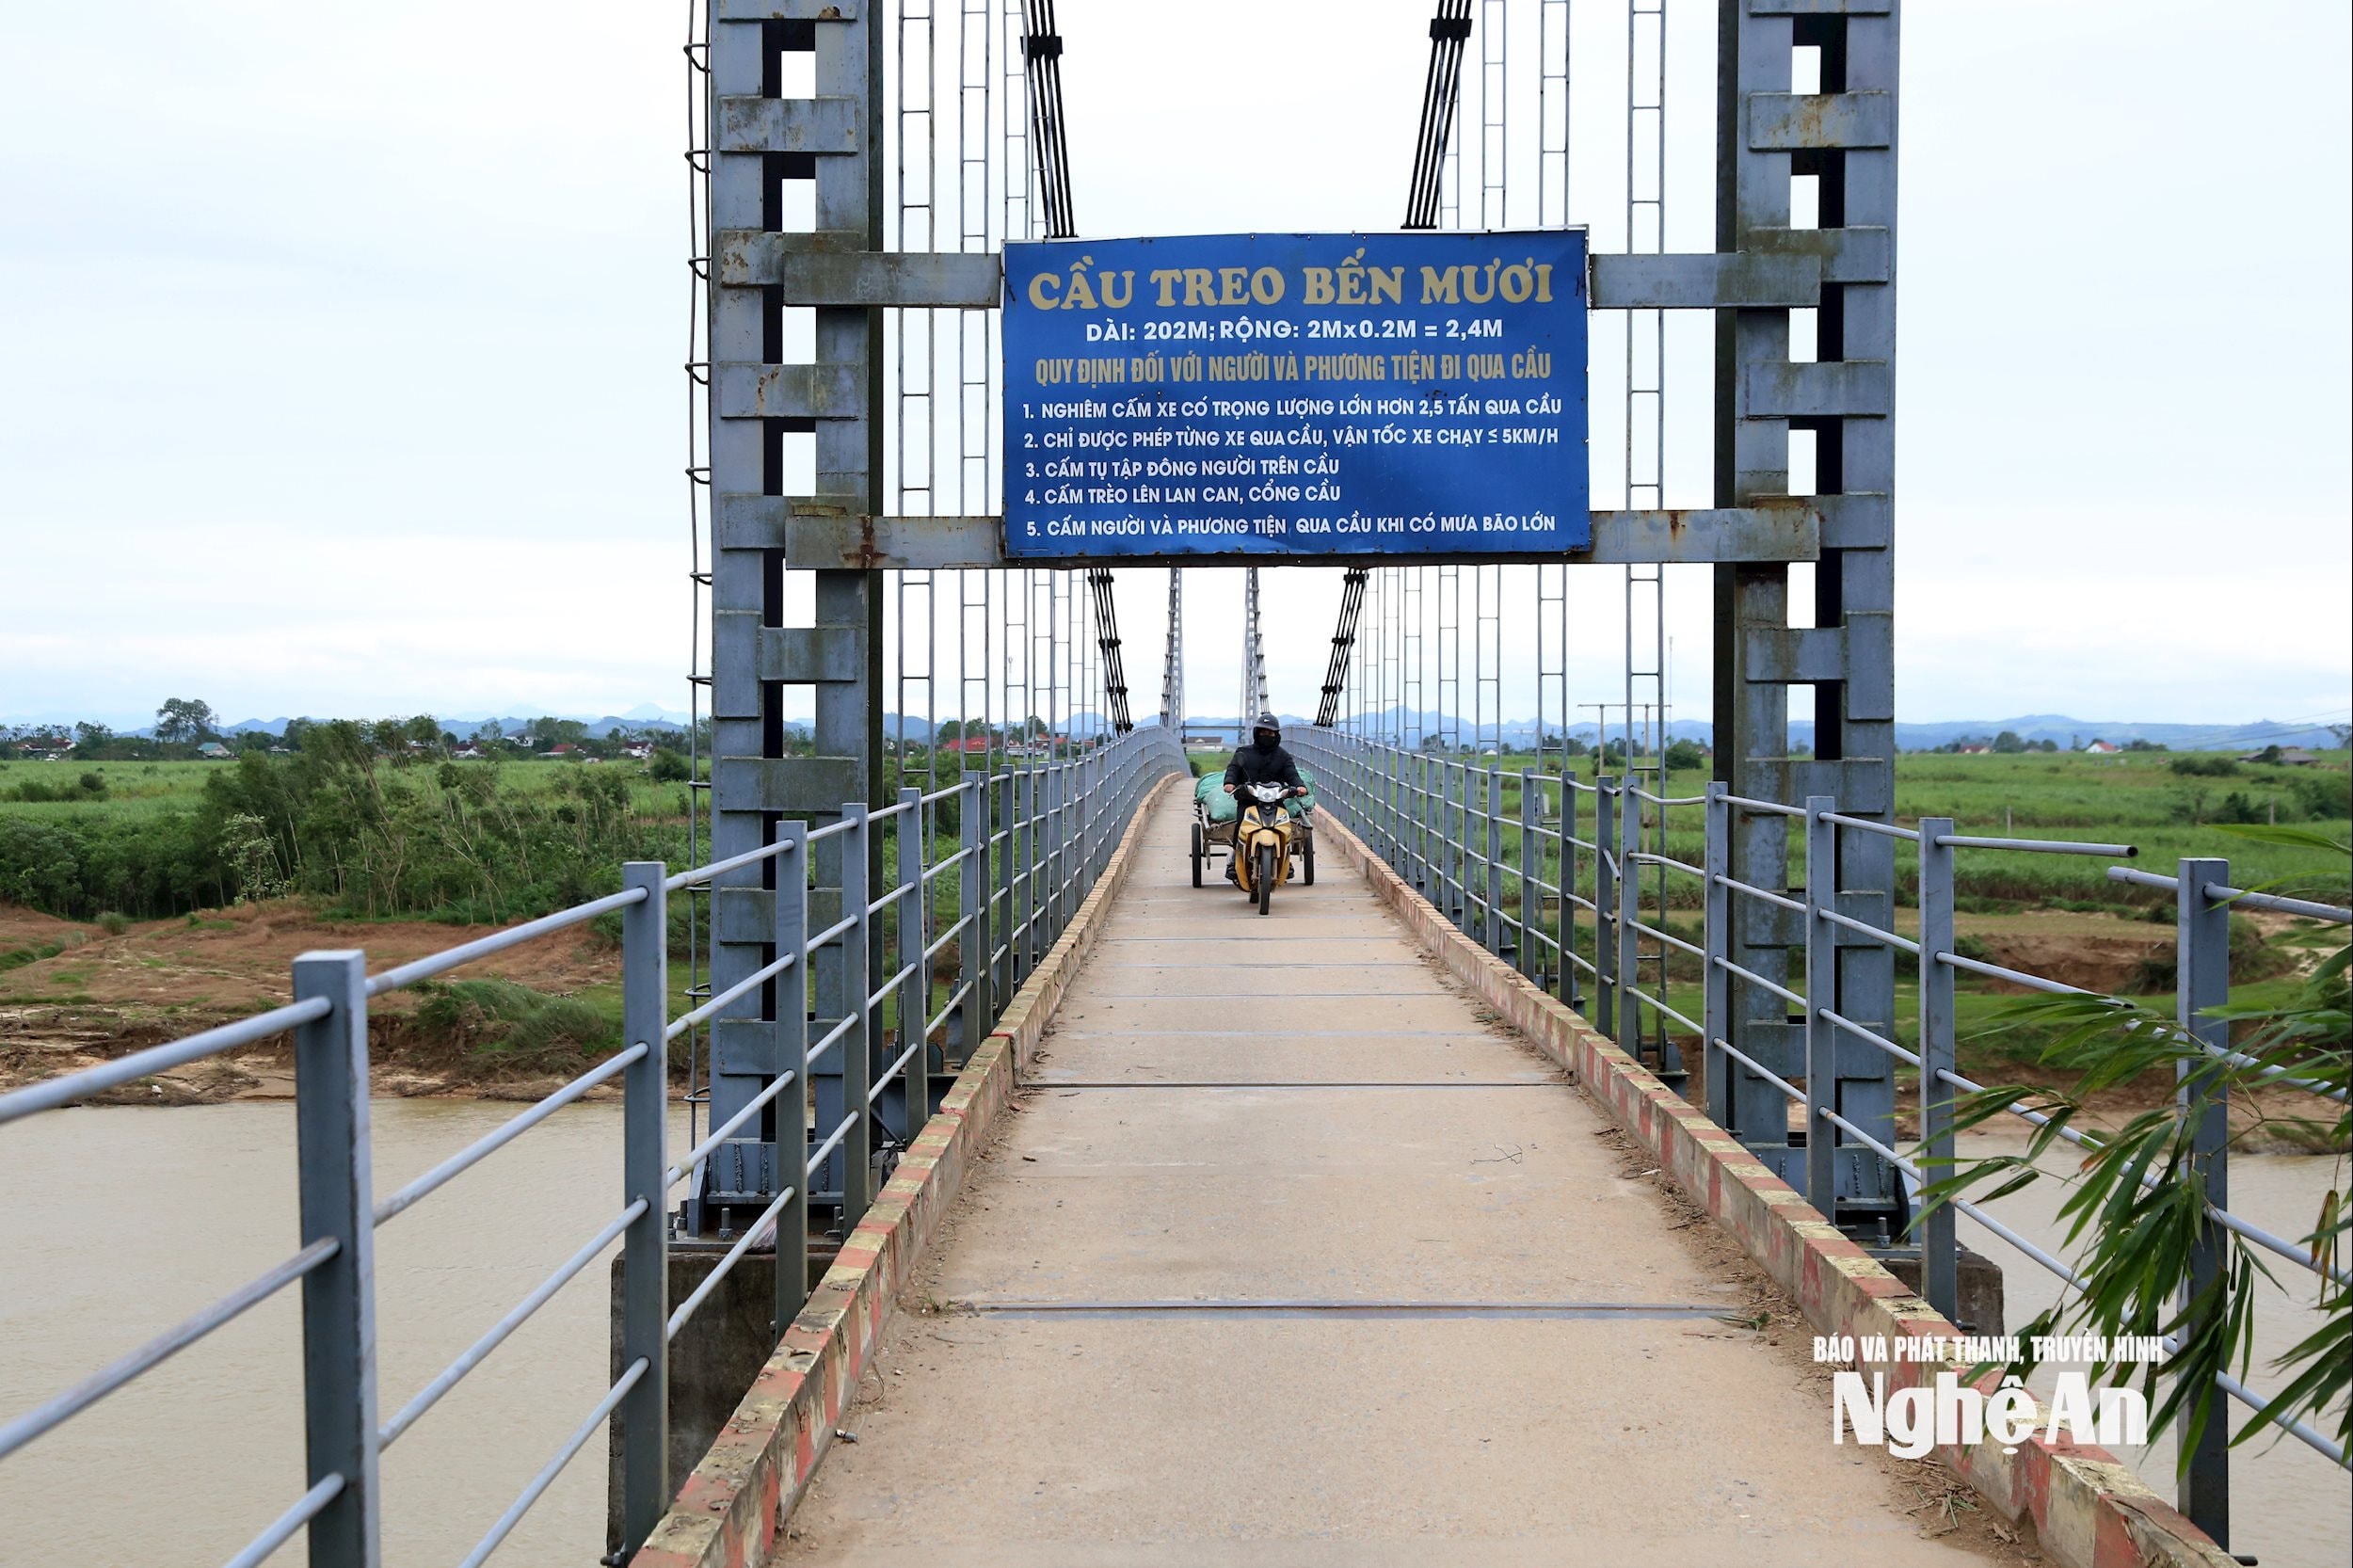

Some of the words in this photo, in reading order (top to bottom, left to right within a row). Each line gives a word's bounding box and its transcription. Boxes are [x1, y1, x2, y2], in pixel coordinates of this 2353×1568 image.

[1028, 255, 1135, 311] CẦU
[1150, 266, 1285, 308] TREO
[1303, 248, 1404, 305] BẾN
[1420, 257, 1553, 304] MƯƠI
[1087, 318, 1135, 342] DÀI:
[1425, 325, 1437, 337] =
[1446, 319, 1502, 341] 2,4M
[1035, 359, 1073, 386] QUY
[1078, 359, 1125, 388] ĐỊNH
[1131, 349, 1163, 383] ĐỐI
[1171, 349, 1202, 382] VỚI
[1209, 352, 1269, 382] NGƯỜI
[1273, 351, 1299, 380] VÀ
[1305, 353, 1385, 381] PHƯƠNG
[1392, 349, 1434, 385] TIỆN
[1441, 353, 1460, 379] ĐI
[1467, 353, 1505, 382] QUA
[1512, 345, 1550, 378] CẦU
[1023, 404, 1033, 419] 1.
[1042, 400, 1107, 419] NGHIÊM
[1112, 396, 1151, 418] CẤM
[1157, 402, 1176, 418] XE
[1181, 396, 1208, 417] CÓ
[1212, 401, 1270, 420] TRỌNG
[1277, 396, 1335, 420] LƯỢNG
[1340, 395, 1372, 415] LỚN
[1378, 398, 1414, 415] HƠN
[1418, 400, 1443, 418] 2,5
[1449, 393, 1480, 414] TẤN
[1485, 399, 1520, 415] QUA
[1526, 392, 1561, 414] CẦU
[1024, 434, 1038, 449] 2.
[1043, 426, 1073, 448] CHỈ
[1079, 430, 1128, 452] ĐƯỢC
[1132, 427, 1172, 447] PHÉP
[1176, 425, 1220, 446] TỪNG
[1225, 430, 1245, 446] XE
[1250, 430, 1285, 447] QUA
[1288, 423, 1327, 447] CẦU,
[1333, 425, 1368, 447] VẬN
[1372, 423, 1406, 444] TỐC
[1413, 429, 1432, 444] XE
[1437, 428, 1483, 447] CHẠY
[1502, 427, 1559, 444] 5KM/H
[1025, 464, 1040, 478] 3.
[1045, 456, 1083, 477] CẤM
[1089, 462, 1107, 480] TỤ
[1112, 458, 1143, 480] TẬP
[1146, 457, 1197, 477] ĐÔNG
[1202, 454, 1256, 476] NGƯỜI
[1260, 456, 1299, 474] TRÊN
[1303, 452, 1339, 474] CẦU
[1025, 490, 1040, 504] 4.
[1044, 483, 1082, 504] CẤM
[1088, 484, 1128, 504] TRÈO
[1132, 484, 1160, 504] LÊN
[1165, 487, 1195, 503] LAN
[1203, 486, 1243, 505] CAN,
[1248, 478, 1300, 502] CỔNG
[1305, 478, 1341, 502] CẦU
[1027, 521, 1041, 536] 5.
[1047, 513, 1085, 536] CẤM
[1091, 514, 1144, 536] NGƯỜI
[1150, 514, 1174, 535] VÀ
[1178, 517, 1248, 535] PHƯƠNG
[1253, 515, 1286, 537] TIỆN
[1296, 517, 1331, 534] QUA
[1336, 510, 1371, 534] CẦU
[1377, 517, 1403, 533] KHI
[1409, 511, 1436, 533] CÓ
[1441, 514, 1478, 532] MƯA
[1483, 513, 1517, 532] BÃO
[1522, 511, 1555, 531] LỚN
